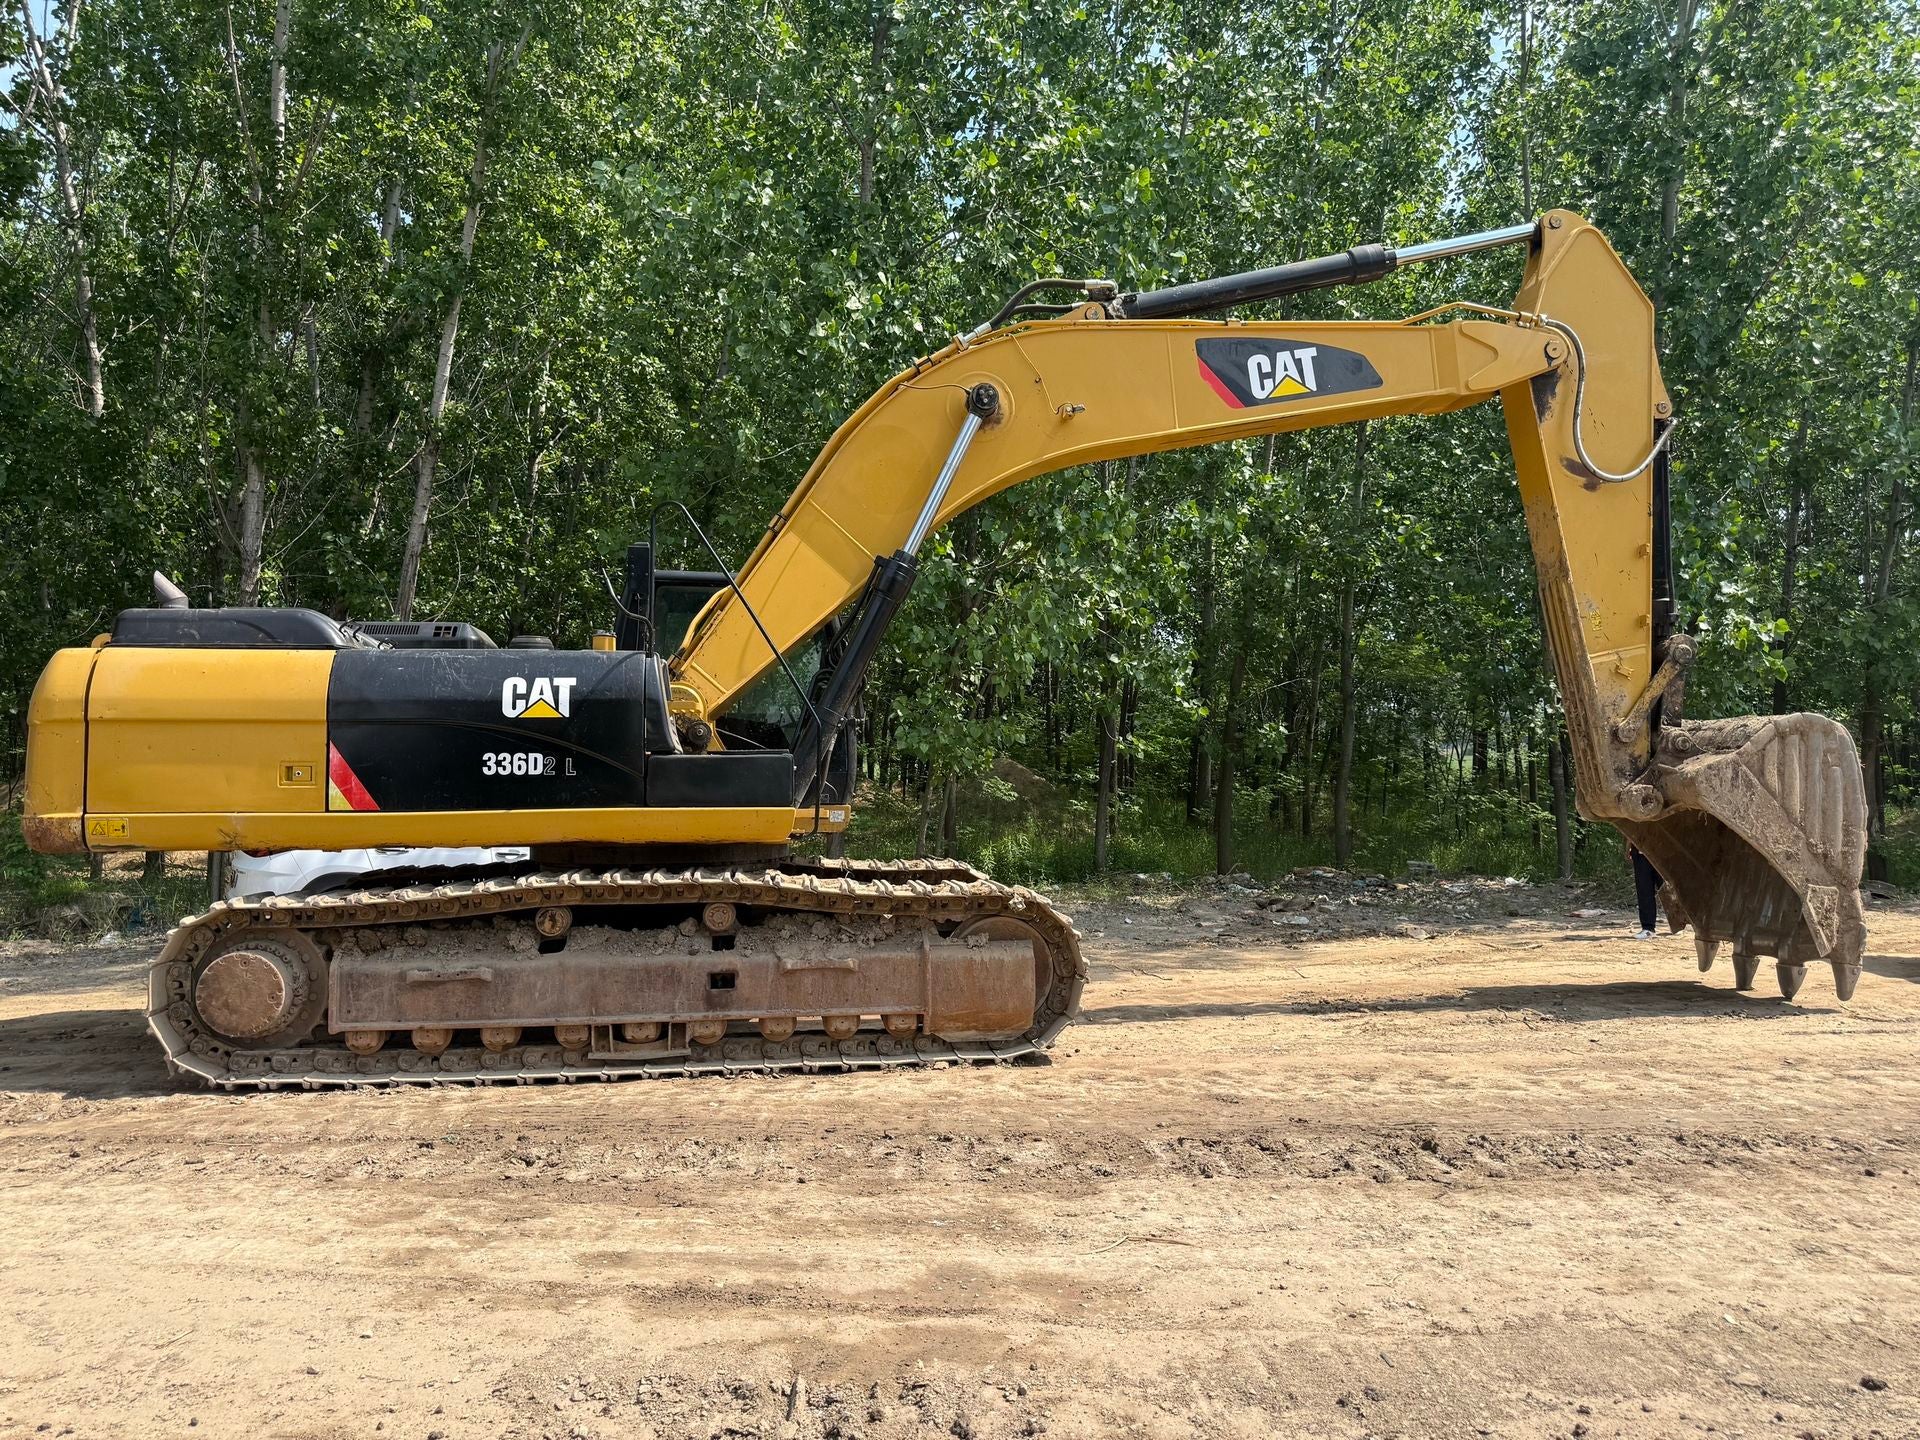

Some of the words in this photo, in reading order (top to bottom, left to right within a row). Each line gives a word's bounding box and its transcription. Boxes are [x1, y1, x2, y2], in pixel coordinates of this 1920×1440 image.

[1247, 347, 1318, 400] CAT
[502, 676, 577, 718] CAT
[565, 757, 577, 776] L
